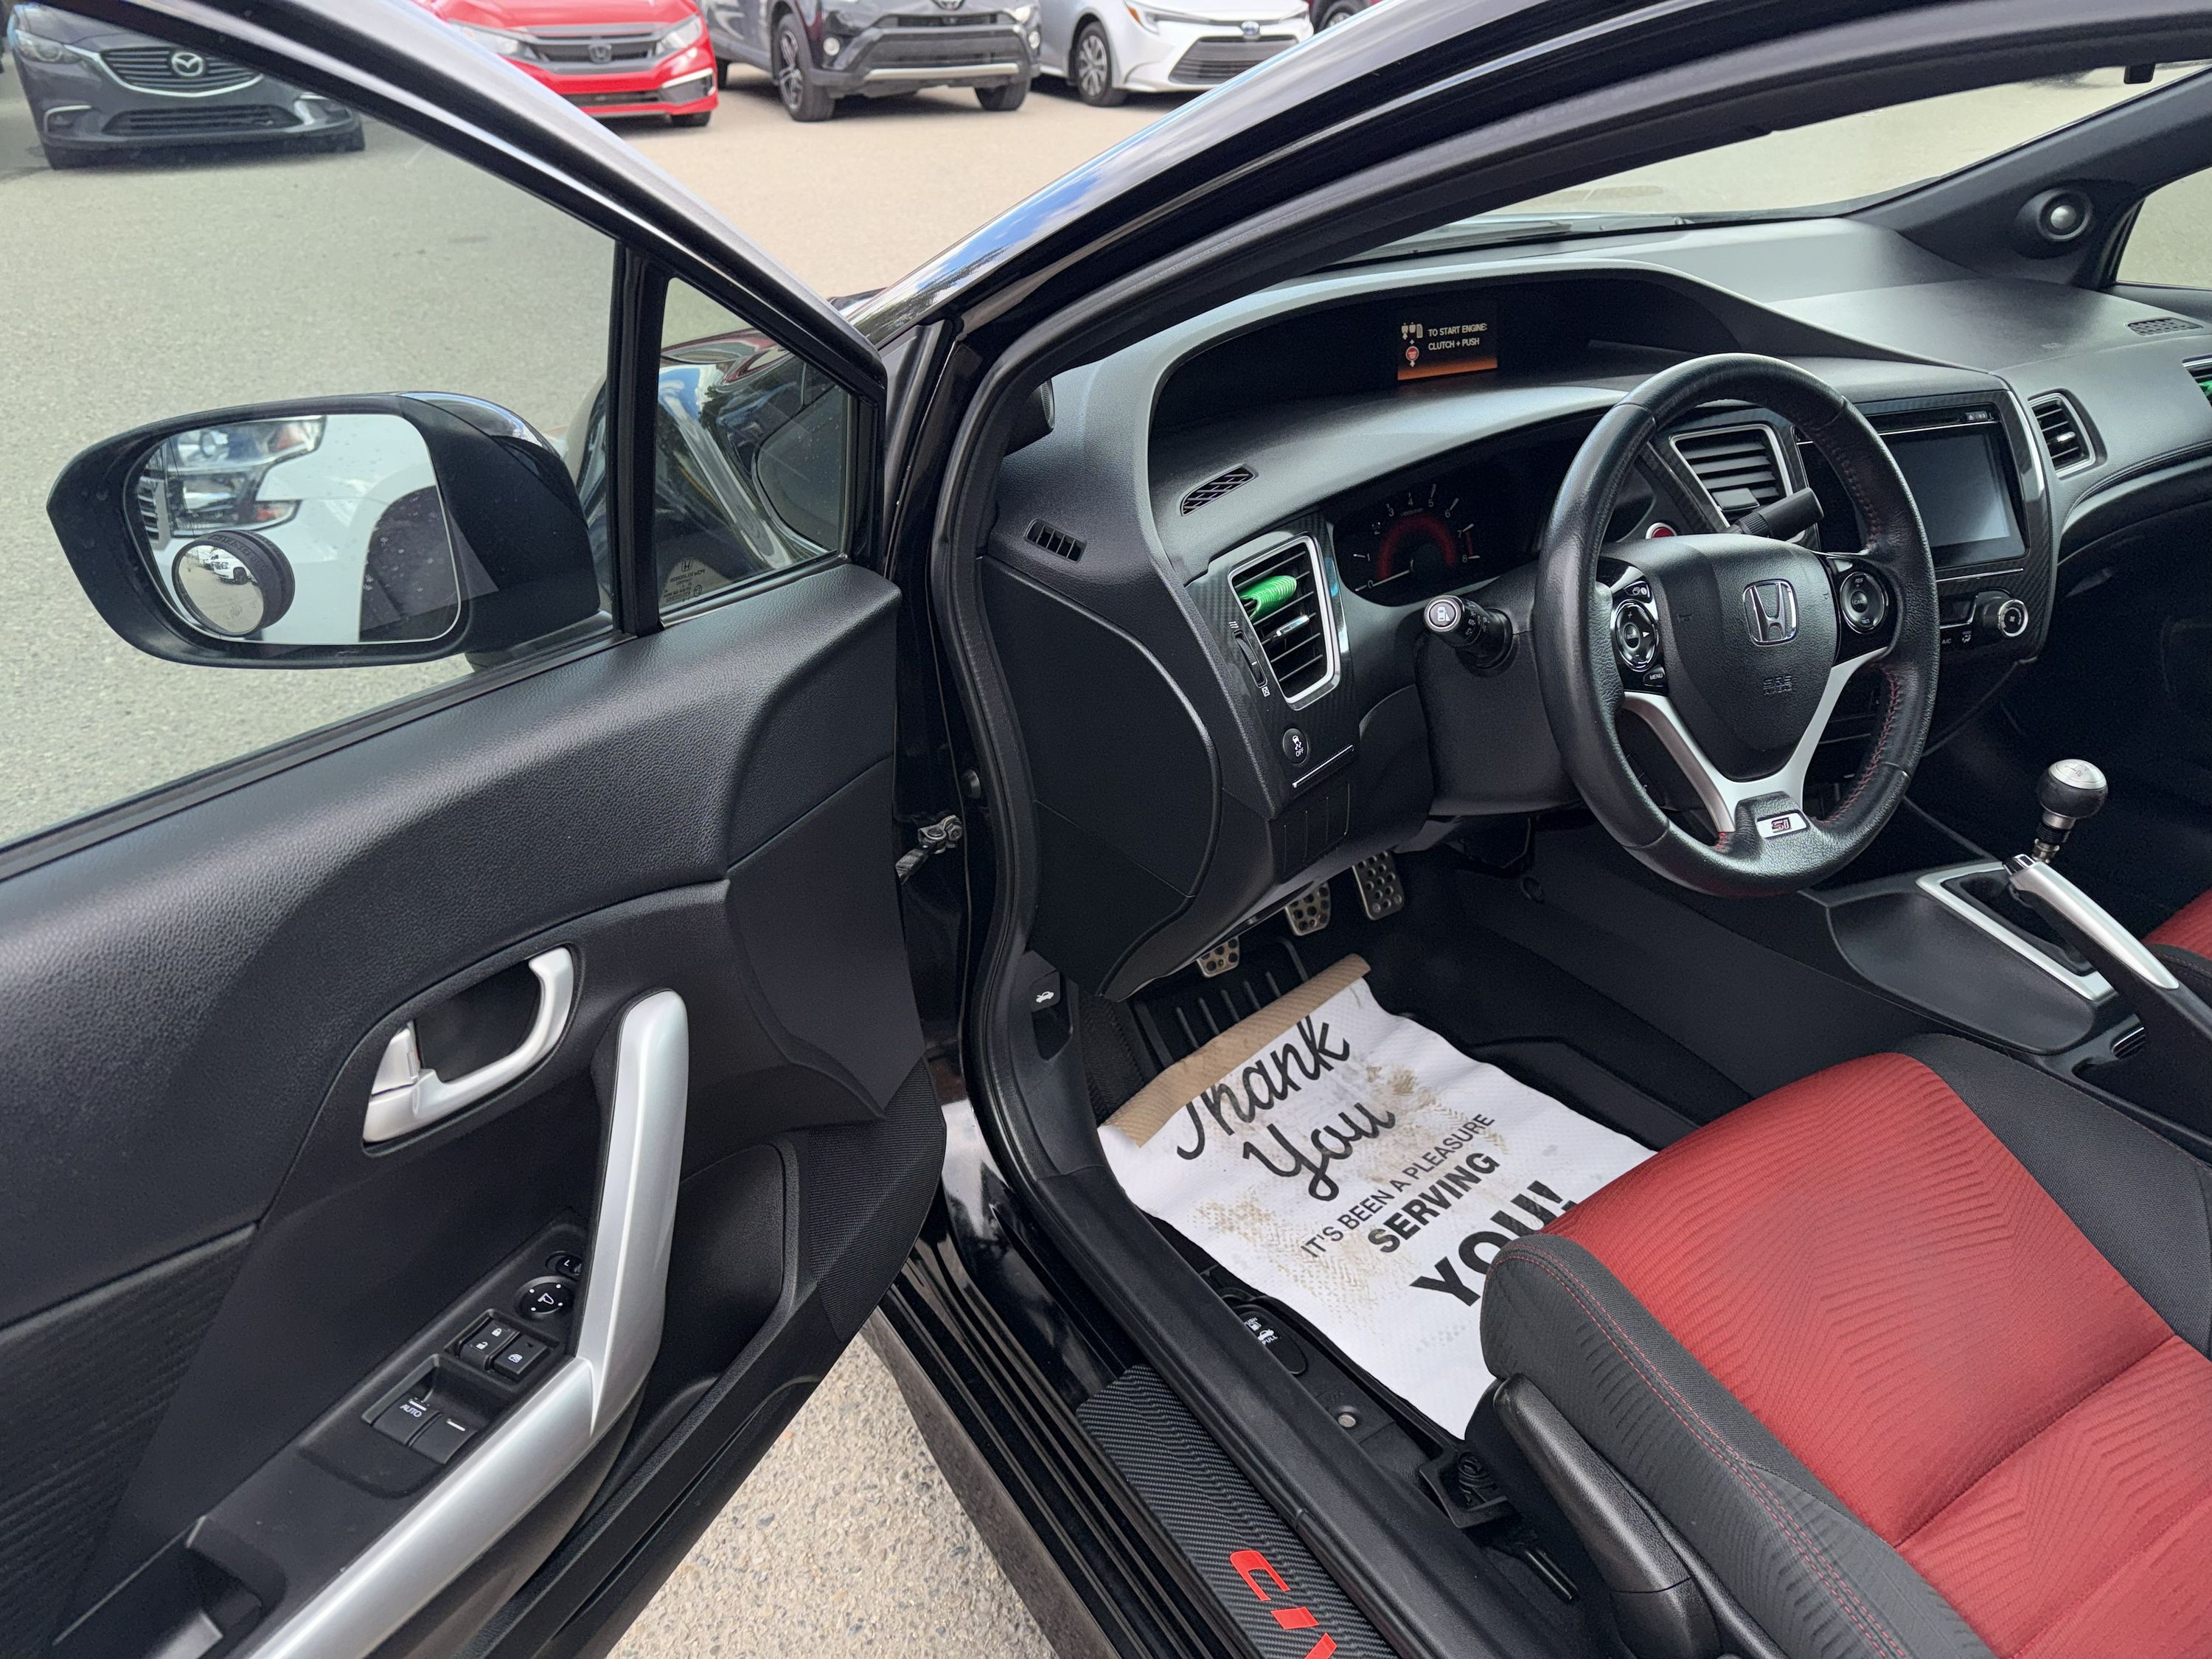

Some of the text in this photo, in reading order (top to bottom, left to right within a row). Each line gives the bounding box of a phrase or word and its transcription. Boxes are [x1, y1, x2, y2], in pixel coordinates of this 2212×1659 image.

[1427, 328, 1439, 337] TO
[1439, 325, 1461, 336] START
[1427, 340, 1455, 351] CLUTCH
[1461, 337, 1480, 347] PUSH
[1427, 498, 1435, 508] 5
[1388, 507, 1395, 518] 3
[1444, 508, 1452, 518] 6
[1649, 672, 1663, 681] MENU
[1295, 747, 1304, 757] OFF
[1242, 1102, 1396, 1202] You
[1300, 1113, 1496, 1258] IT'S BEEN A PLEASURE
[1368, 1152, 1501, 1253] SERVING
[1409, 1180, 1578, 1307] YOU!
[1262, 1335, 1279, 1346] PULL
[399, 1403, 423, 1418] AUTO
